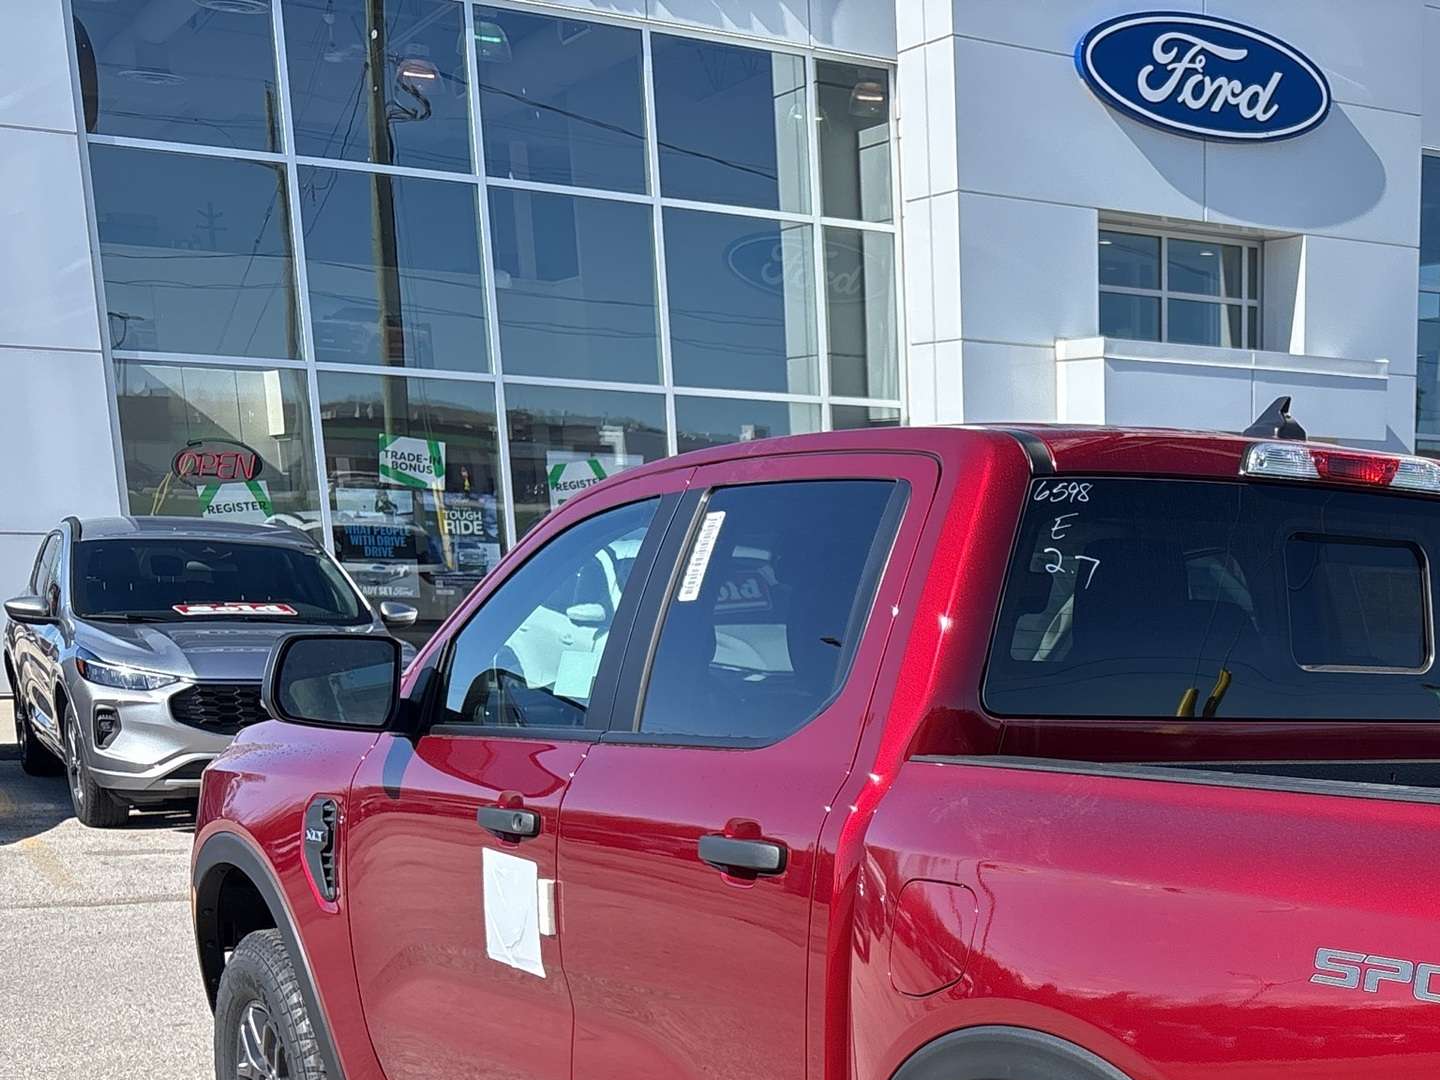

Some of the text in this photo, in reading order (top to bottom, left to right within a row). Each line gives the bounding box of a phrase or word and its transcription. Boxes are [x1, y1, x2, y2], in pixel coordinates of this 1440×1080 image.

[1138, 32, 1283, 121] Ford
[384, 449, 441, 466] TRADE-IN
[178, 451, 256, 480] OPEN
[391, 461, 433, 474] BONUS
[1034, 481, 1094, 503] 6598
[207, 501, 267, 514] REGISTER
[443, 510, 482, 521] TOUGH
[444, 520, 484, 535] RIDE
[364, 546, 396, 558] DRIVE
